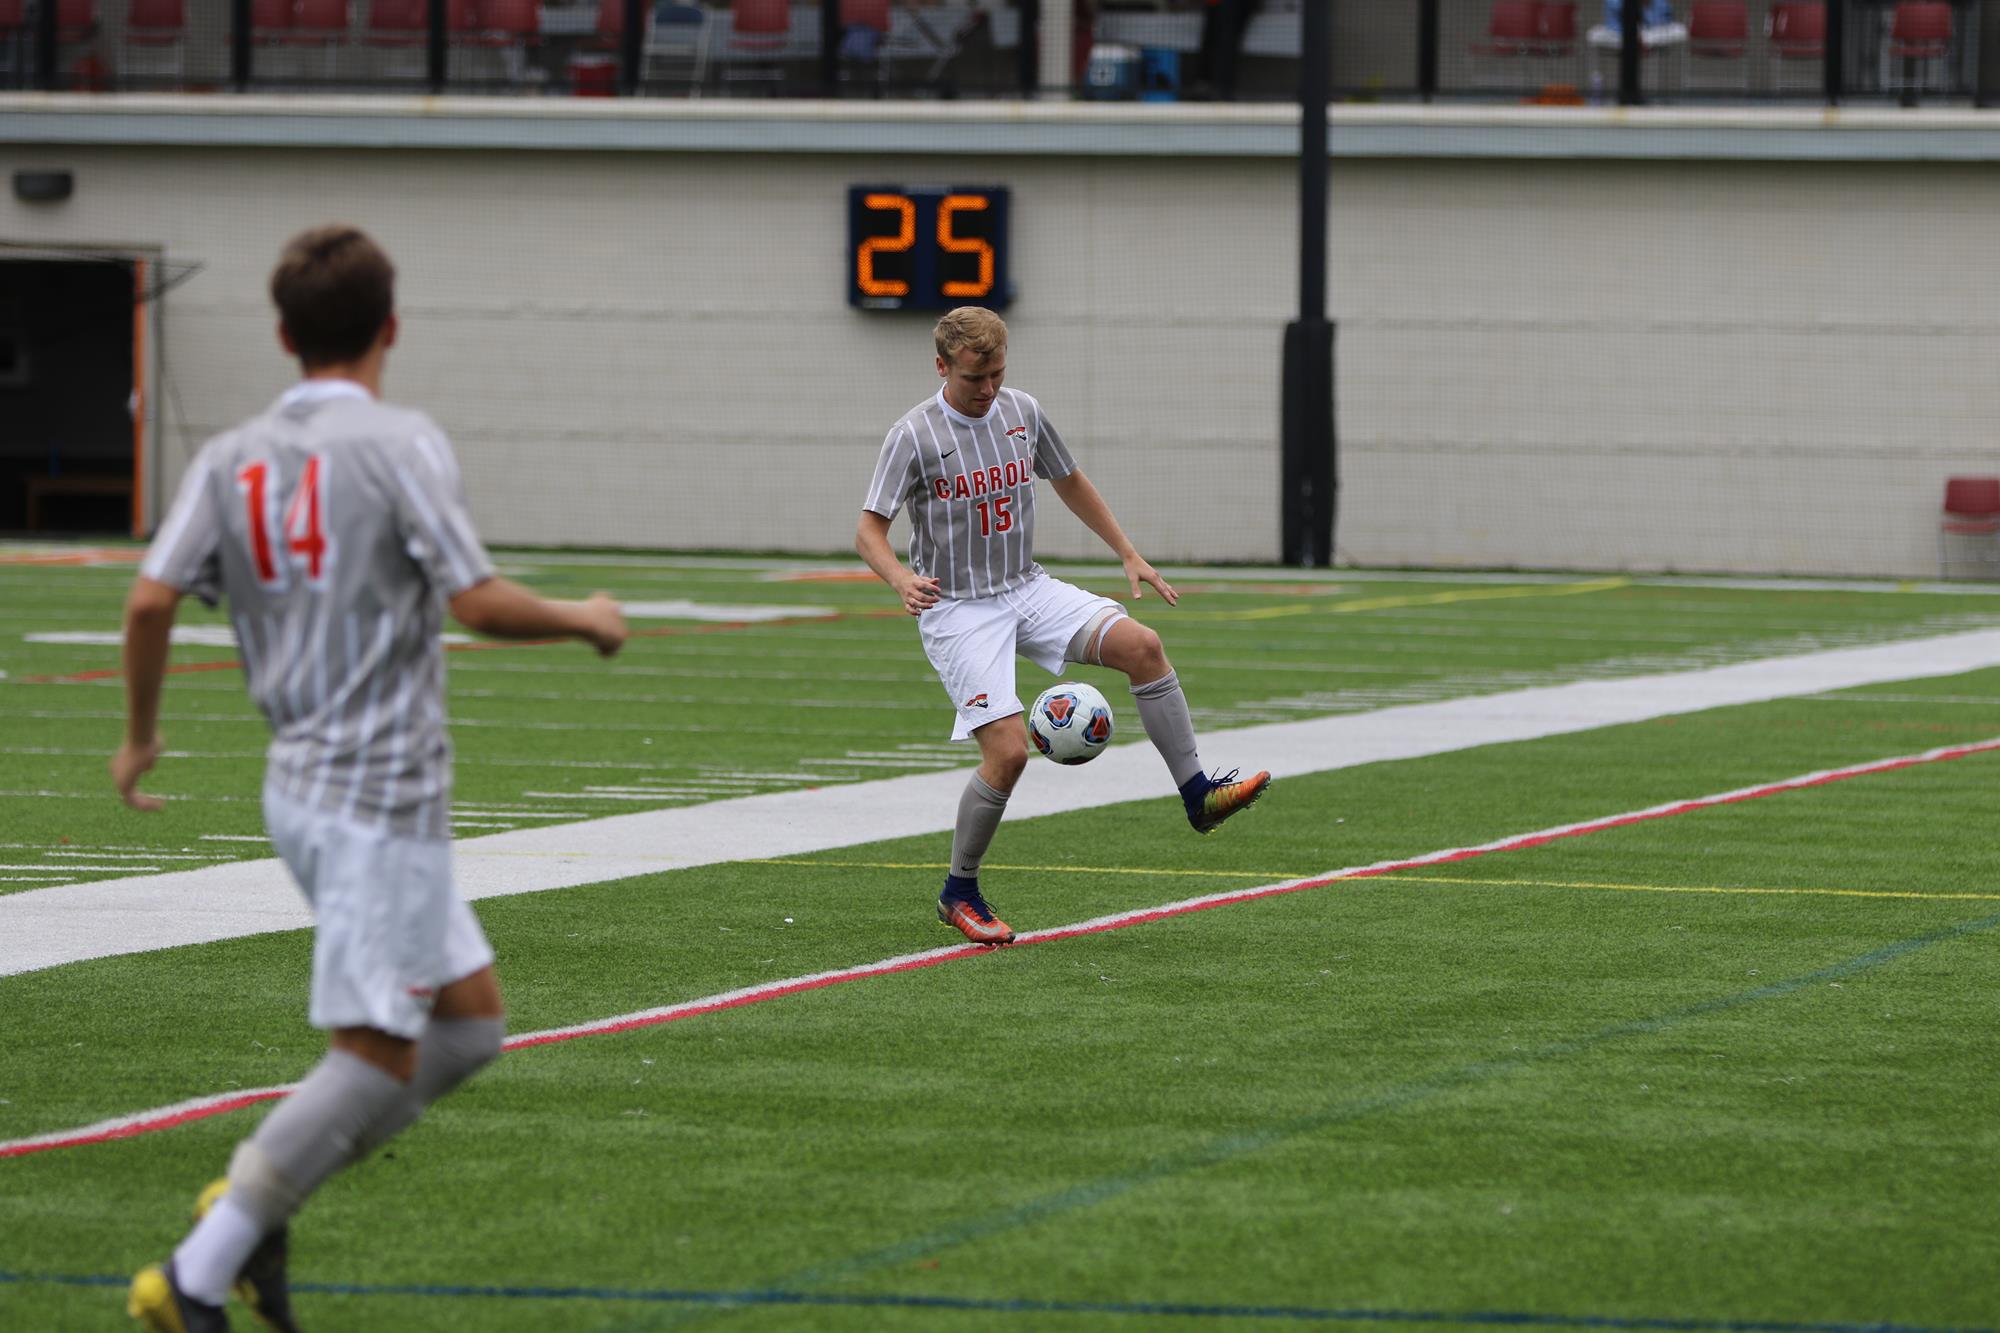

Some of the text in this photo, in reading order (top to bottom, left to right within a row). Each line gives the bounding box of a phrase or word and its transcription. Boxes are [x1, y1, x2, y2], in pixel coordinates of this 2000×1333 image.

[857, 194, 995, 298] 25
[237, 454, 330, 584] 14
[975, 496, 1013, 537] 15
